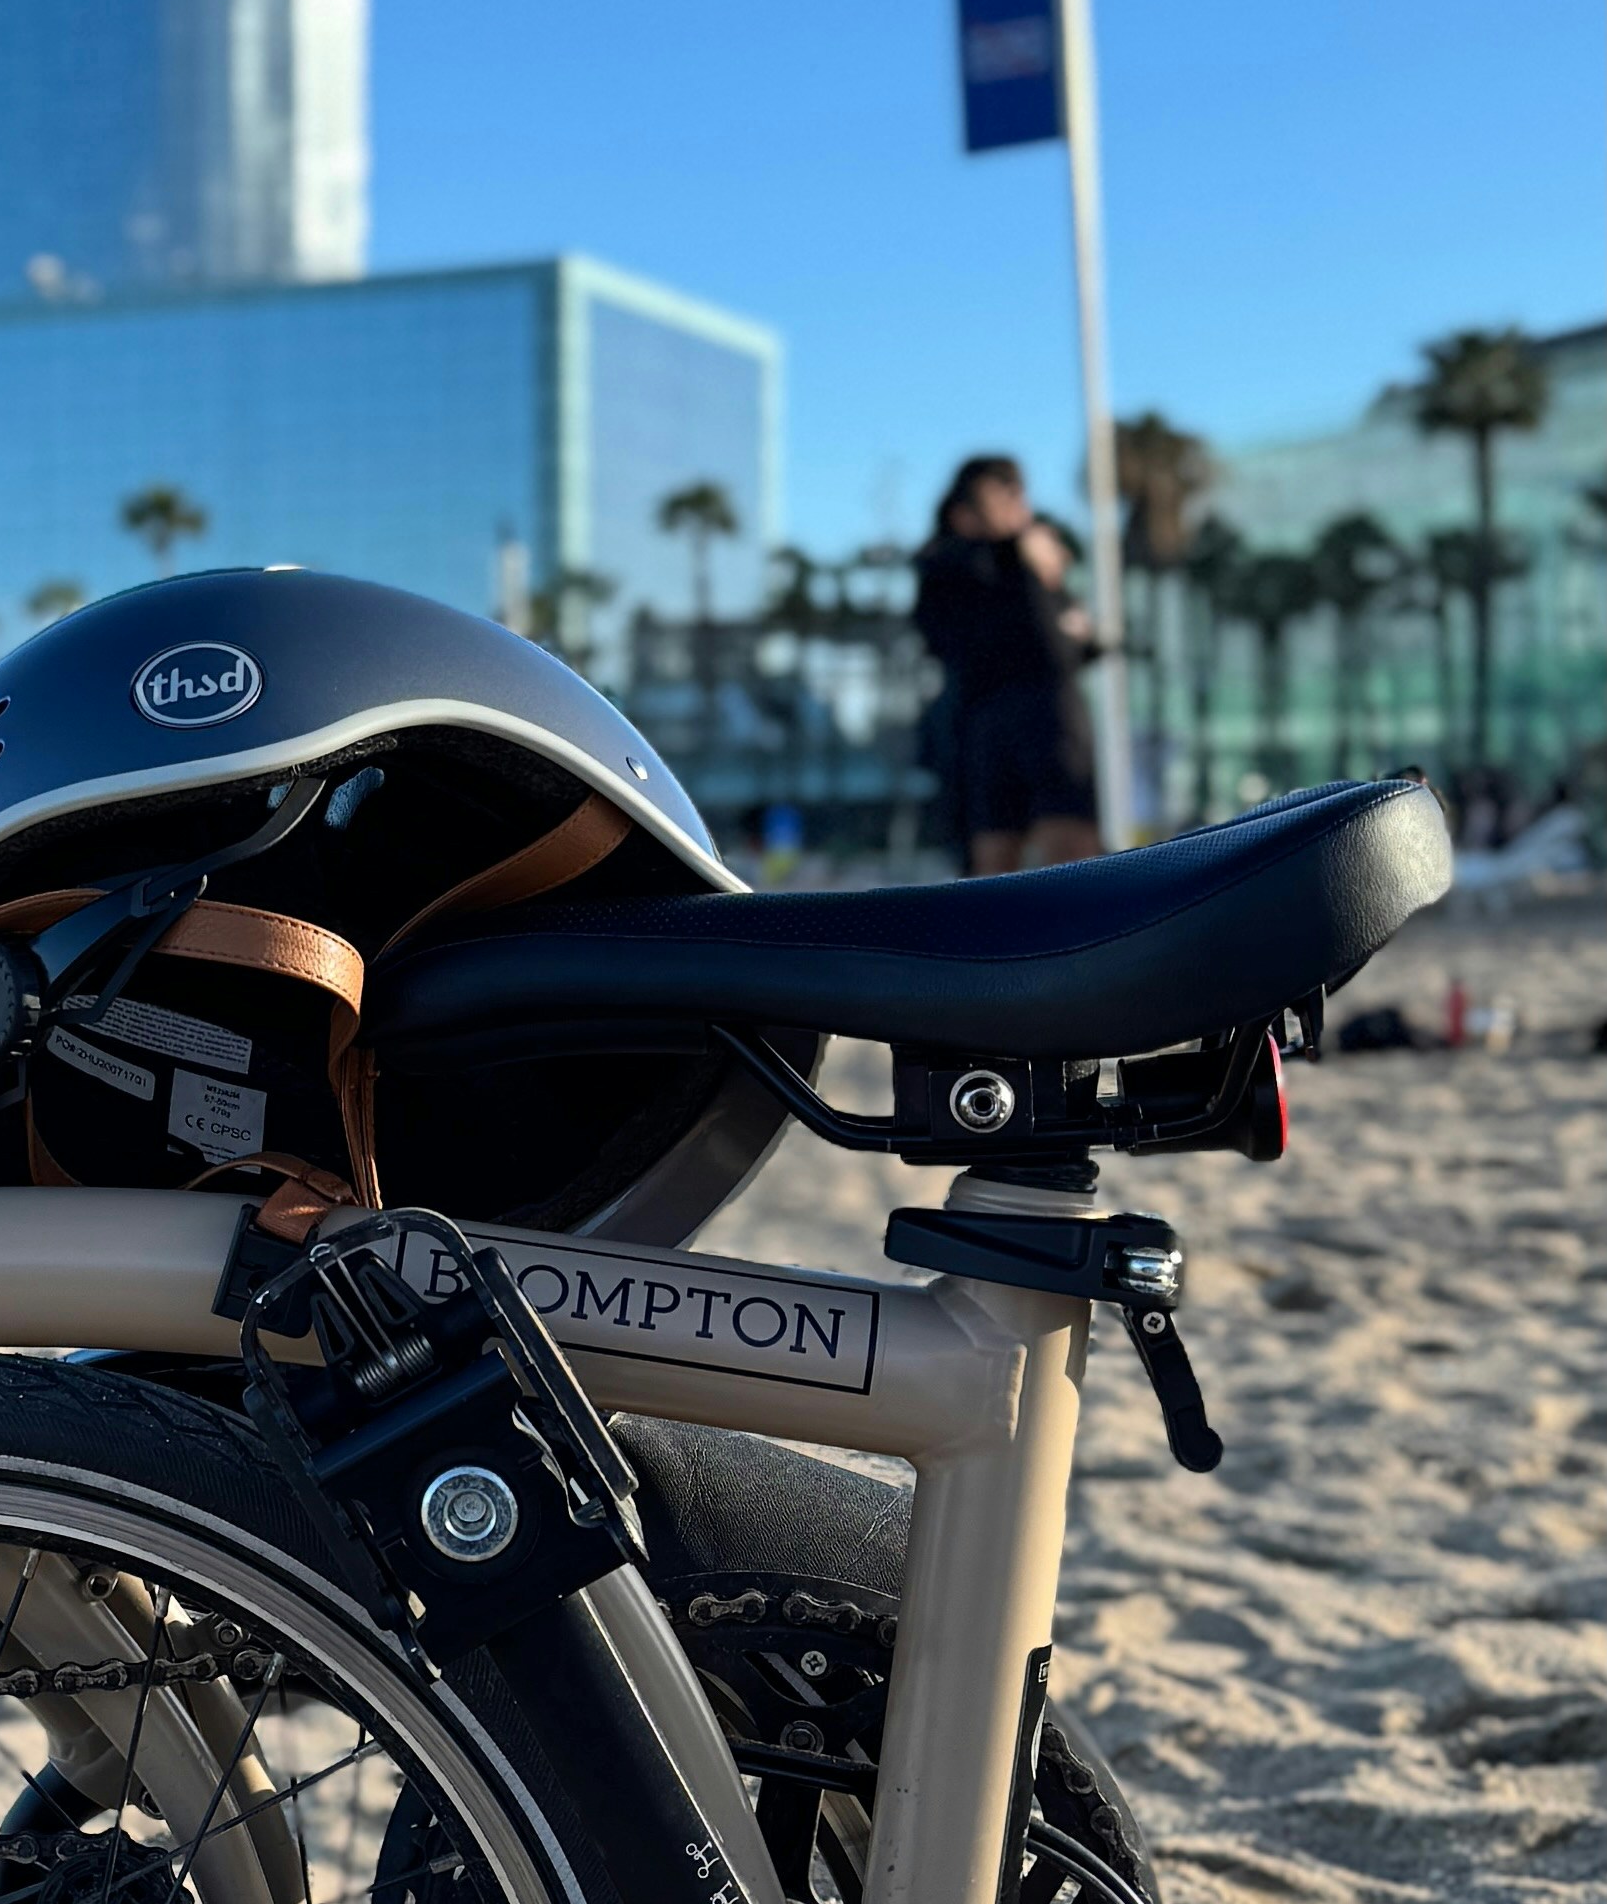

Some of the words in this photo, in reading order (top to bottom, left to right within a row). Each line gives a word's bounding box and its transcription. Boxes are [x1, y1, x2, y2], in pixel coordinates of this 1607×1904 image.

[148, 657, 245, 706] thsd
[211, 1122, 251, 1141] CPSC
[424, 1248, 846, 1359] BOMPTON
